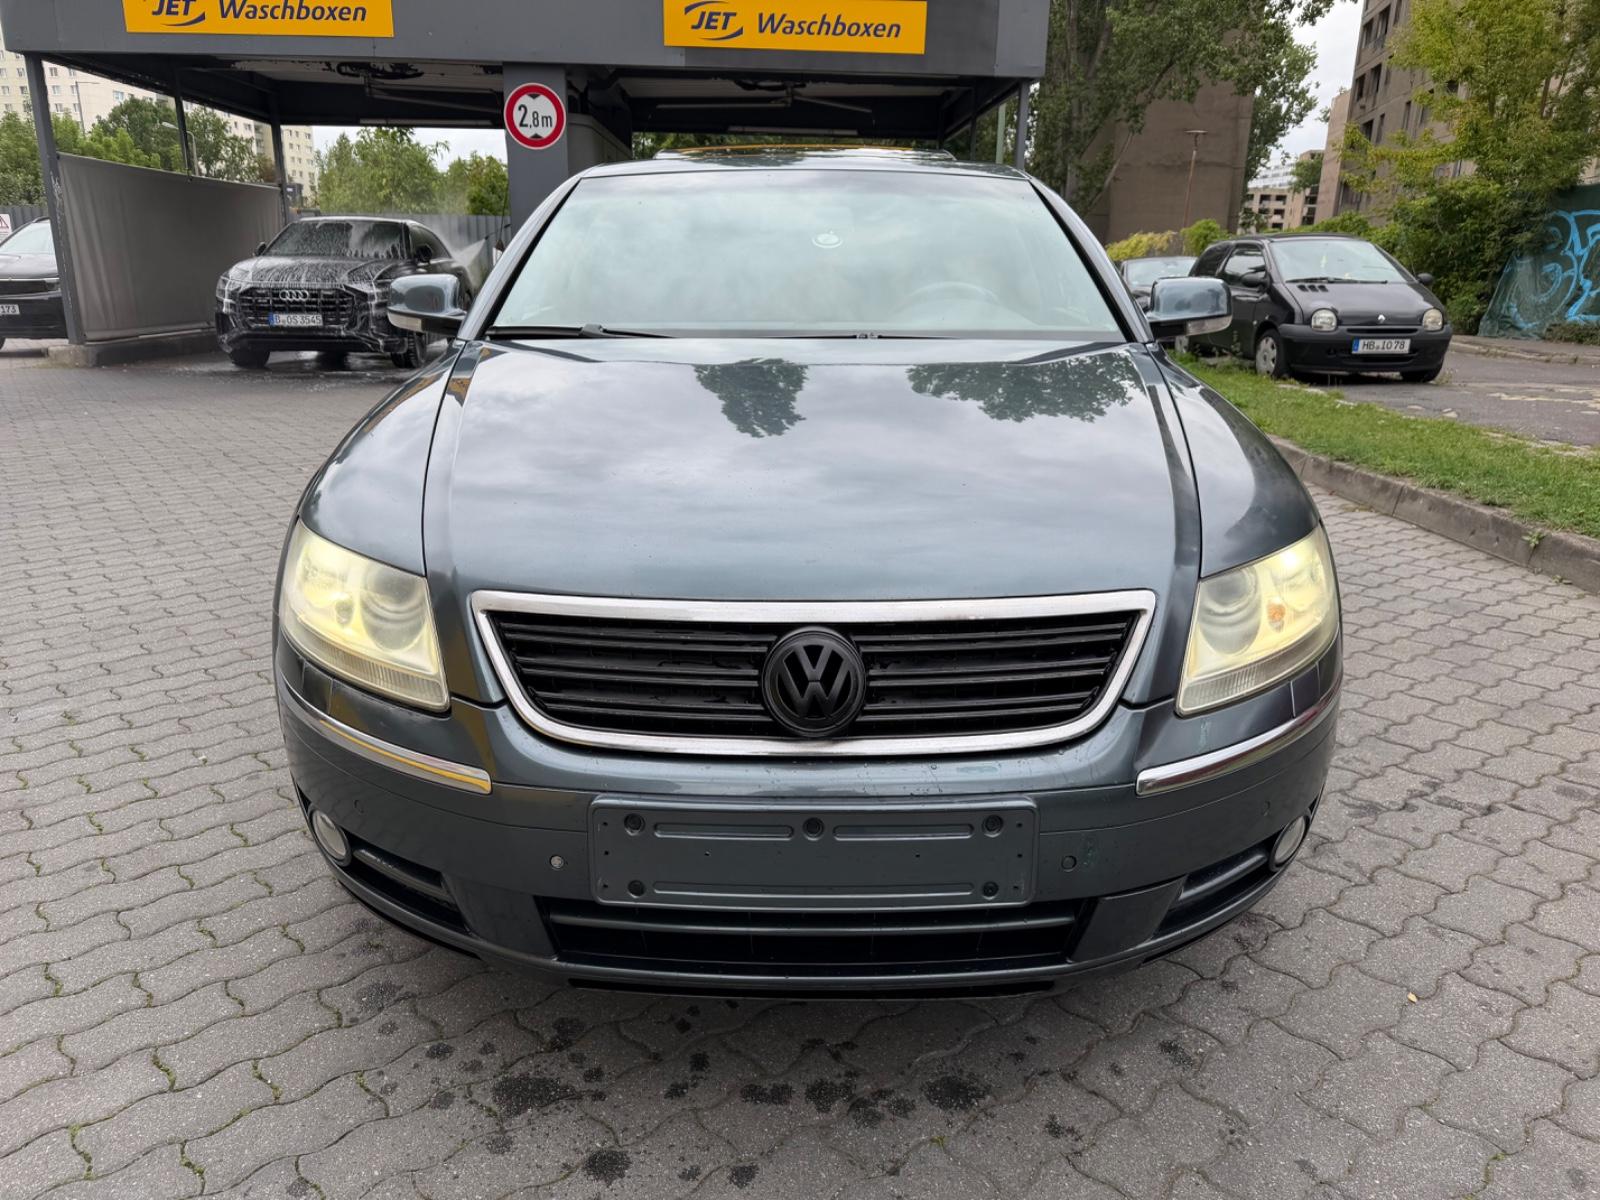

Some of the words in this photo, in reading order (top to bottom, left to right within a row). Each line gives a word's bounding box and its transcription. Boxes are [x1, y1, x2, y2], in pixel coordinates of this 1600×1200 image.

[152, 0, 197, 16] JET
[219, 0, 367, 21] Waschboxen
[691, 11, 737, 31] JET
[757, 12, 901, 38] Waschboxen
[773, 638, 855, 722] VW
